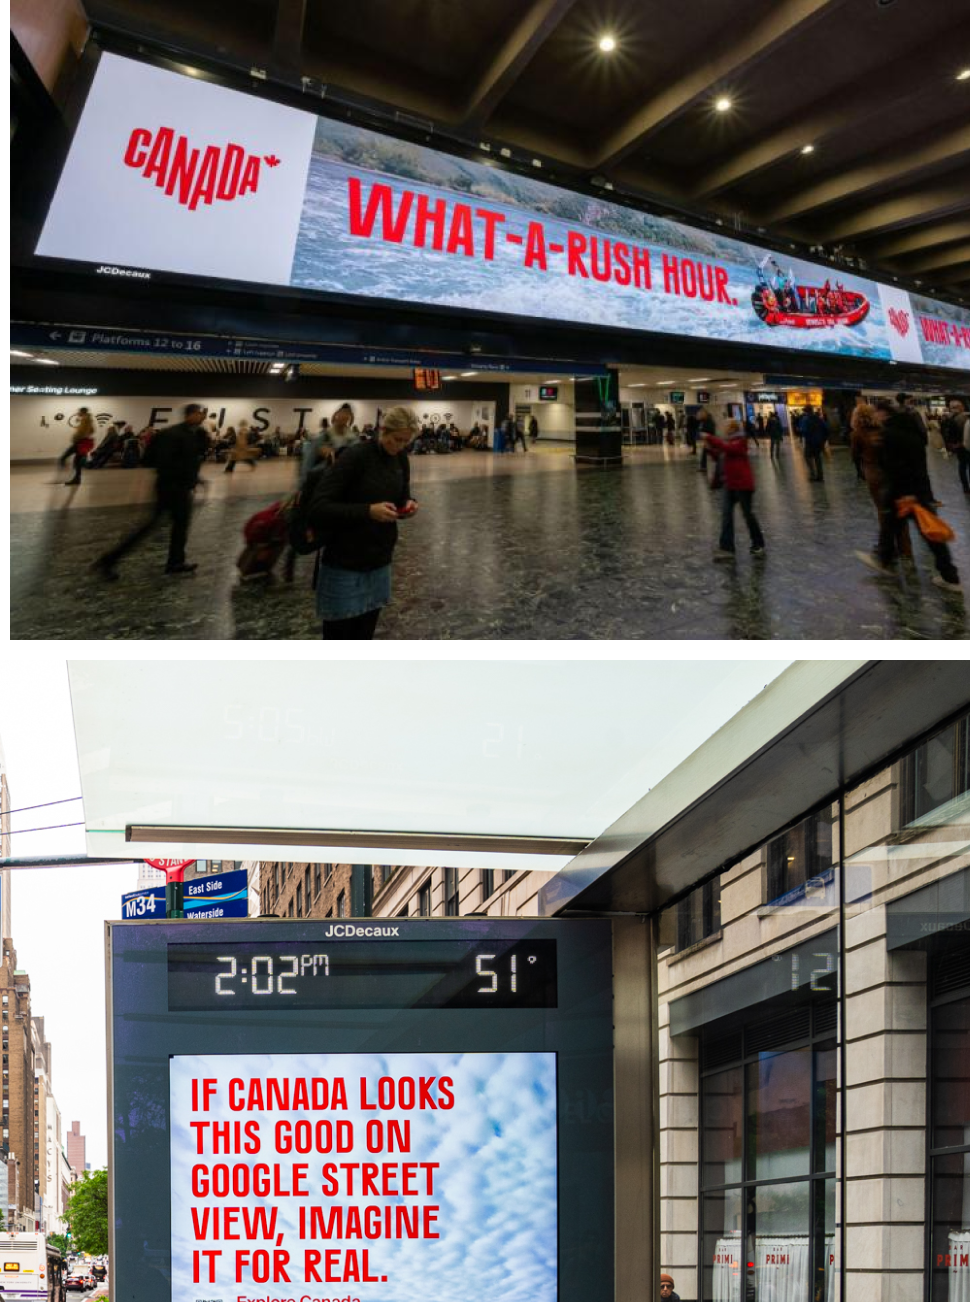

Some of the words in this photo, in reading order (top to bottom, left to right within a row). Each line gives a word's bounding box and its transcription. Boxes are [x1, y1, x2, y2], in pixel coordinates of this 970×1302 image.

[123, 126, 261, 211] CANADA
[348, 176, 652, 291] WHAT-A-RUSH
[662, 252, 738, 306] HOUR.
[96, 264, 151, 280] JCDecaux
[91, 332, 151, 347] Platforms
[154, 336, 169, 348] 12
[172, 338, 184, 349] to
[185, 340, 202, 351] 16
[27, 385, 63, 396] Seating
[64, 386, 98, 396] Lounge
[188, 884, 205, 896] East
[206, 880, 223, 892] Side
[125, 893, 157, 918] M34
[187, 907, 224, 919] Waterside
[325, 924, 400, 938] JCDecaux
[191, 1078, 218, 1112] IF
[229, 1077, 349, 1112] CANADA
[360, 1076, 455, 1111] LOOKS
[190, 1121, 261, 1155] THIS
[274, 1119, 354, 1155] GOOD
[366, 1119, 412, 1154] ON
[191, 1163, 310, 1199] GOOGLE
[321, 1162, 440, 1198] STREET
[190, 1206, 285, 1247] VIEW,
[298, 1205, 440, 1240] IMAGINE
[192, 1250, 223, 1284] IT
[235, 1249, 292, 1284] FOR
[304, 1248, 388, 1283] REAL.
[765, 1253, 791, 1266] PRIMI
